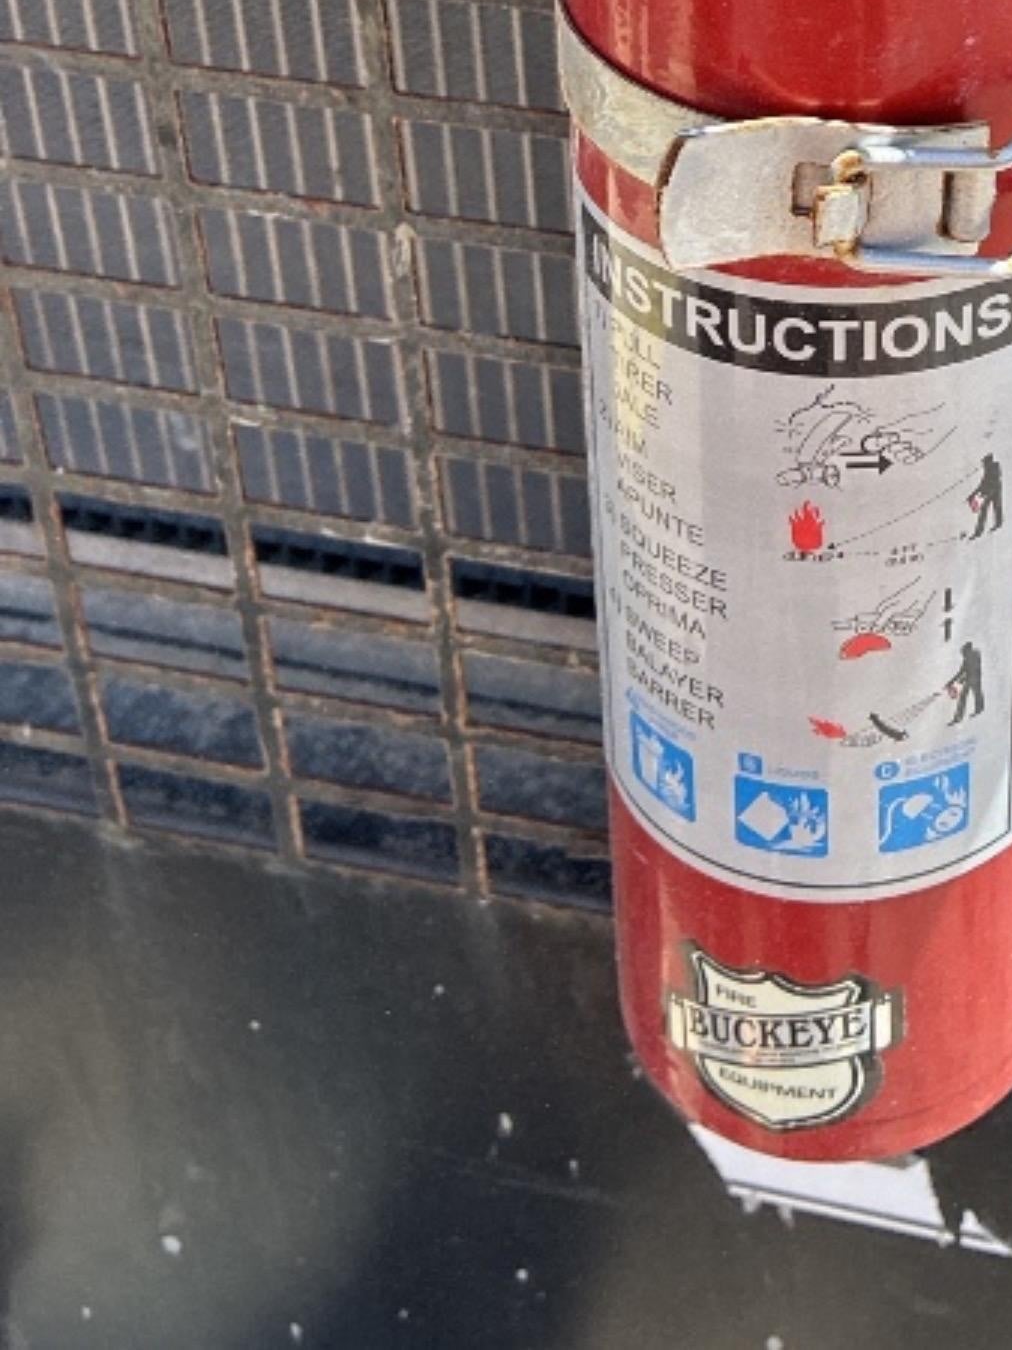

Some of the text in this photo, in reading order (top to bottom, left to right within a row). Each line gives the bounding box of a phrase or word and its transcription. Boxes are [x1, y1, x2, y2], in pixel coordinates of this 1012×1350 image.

[592, 233, 1012, 362] INSTRUCTIONS
[617, 478, 704, 547] APUNTE
[620, 513, 728, 593] SQUEEZE
[620, 539, 728, 620] PRESSER
[622, 568, 707, 639] OPRIMA
[625, 604, 700, 665] SWEEP
[626, 628, 724, 708] BALAYER
[689, 1004, 868, 1049] BUCKEYE
[715, 983, 757, 1009] FIRE
[719, 1065, 838, 1100] EQUIPMENT
